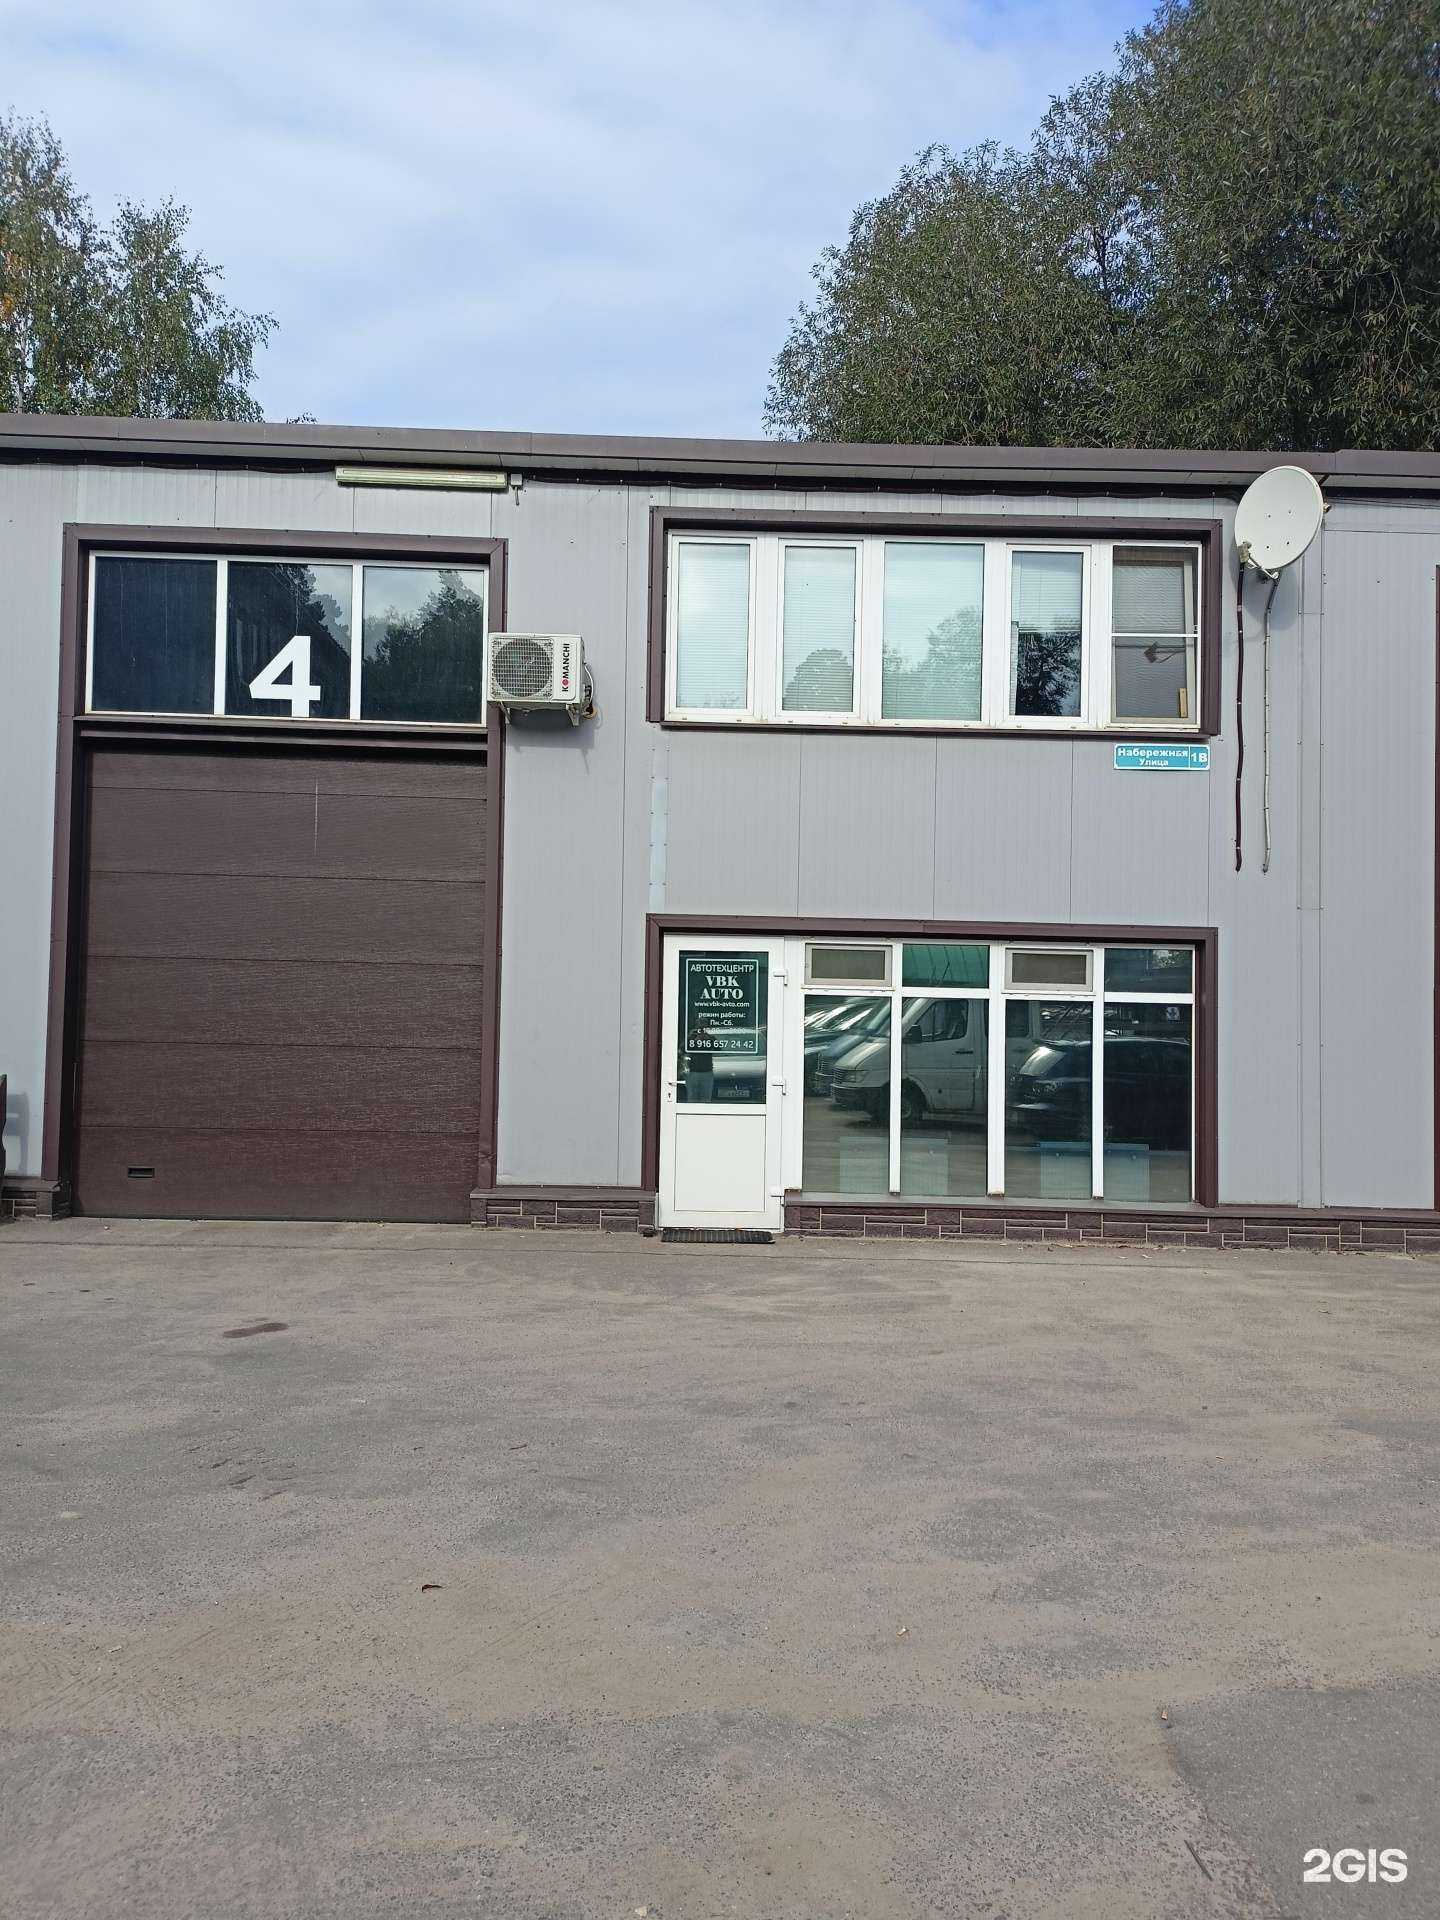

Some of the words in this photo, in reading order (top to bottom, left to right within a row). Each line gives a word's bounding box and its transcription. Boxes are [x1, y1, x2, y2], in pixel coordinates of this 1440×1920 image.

[561, 643, 570, 692] KOMANCHI
[249, 636, 321, 717] 4
[1117, 748, 1188, 758] Набережная
[690, 964, 755, 973] АВТОТЕХЦЕНТР
[705, 976, 740, 987] VBK
[700, 988, 744, 1000] AUTO
[689, 1040, 695, 1048] 8
[697, 1040, 712, 1048] 916
[713, 1040, 729, 1048] 657
[731, 1040, 741, 1049] 24
[743, 1040, 754, 1049] 42
